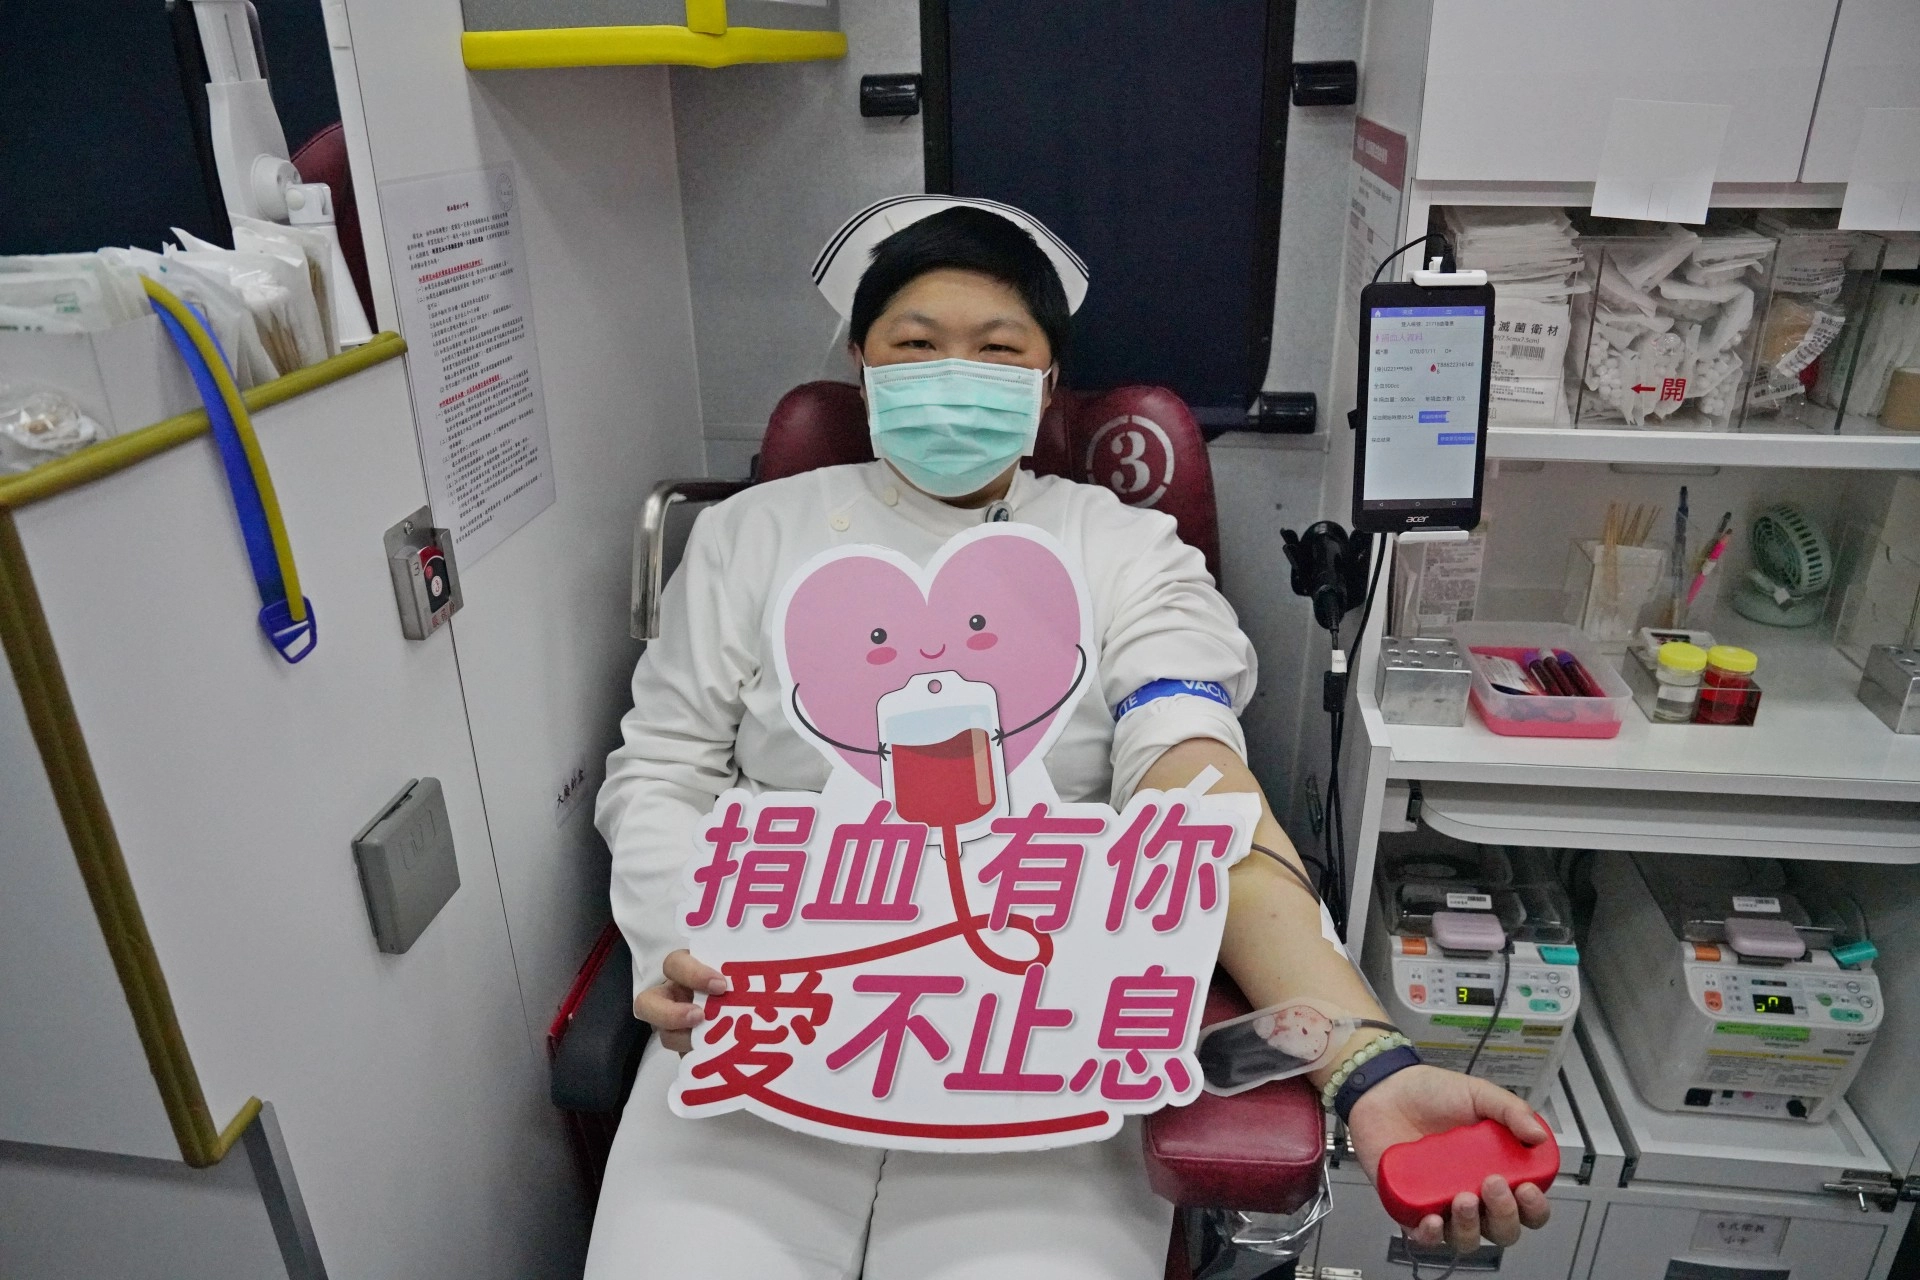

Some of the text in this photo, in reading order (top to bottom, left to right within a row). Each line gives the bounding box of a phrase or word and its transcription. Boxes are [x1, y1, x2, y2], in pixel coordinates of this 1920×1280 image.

[1498, 321, 1559, 337] 滅菌衛材
[1660, 377, 1686, 401] 開
[1111, 430, 1151, 494] 3
[1405, 515, 1430, 523] acer
[413, 561, 421, 577] 3
[1181, 680, 1230, 707] VACU
[685, 801, 1234, 933] 捐血有你
[680, 963, 1197, 1107] 愛不止息
